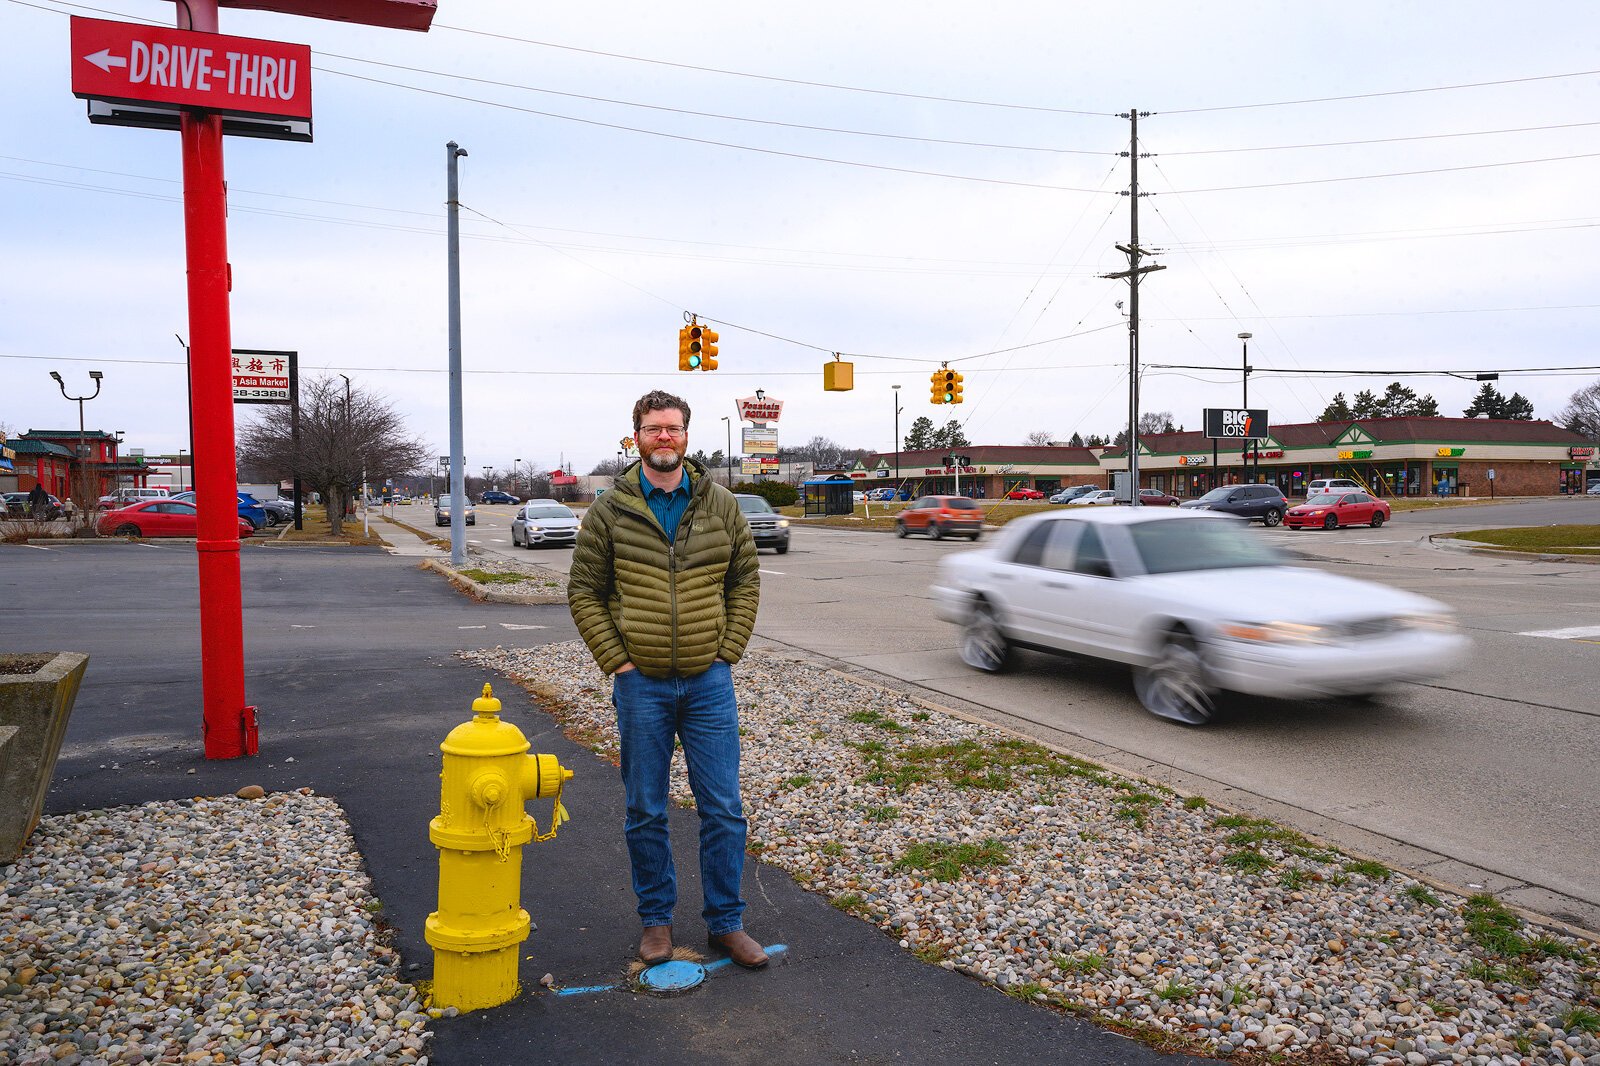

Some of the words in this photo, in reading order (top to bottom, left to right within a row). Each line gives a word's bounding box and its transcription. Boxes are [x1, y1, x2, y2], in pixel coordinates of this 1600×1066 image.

[129, 40, 297, 101] DRIVE-THRU
[239, 378, 257, 386] Asia
[259, 378, 287, 387] Market
[233, 389, 286, 397] 28-3388
[742, 401, 780, 410] Fountain
[744, 410, 779, 419] SQUARE
[1222, 410, 1249, 424] BIG
[1338, 450, 1373, 459] SUBWAY
[1437, 447, 1465, 456] SUBWAY
